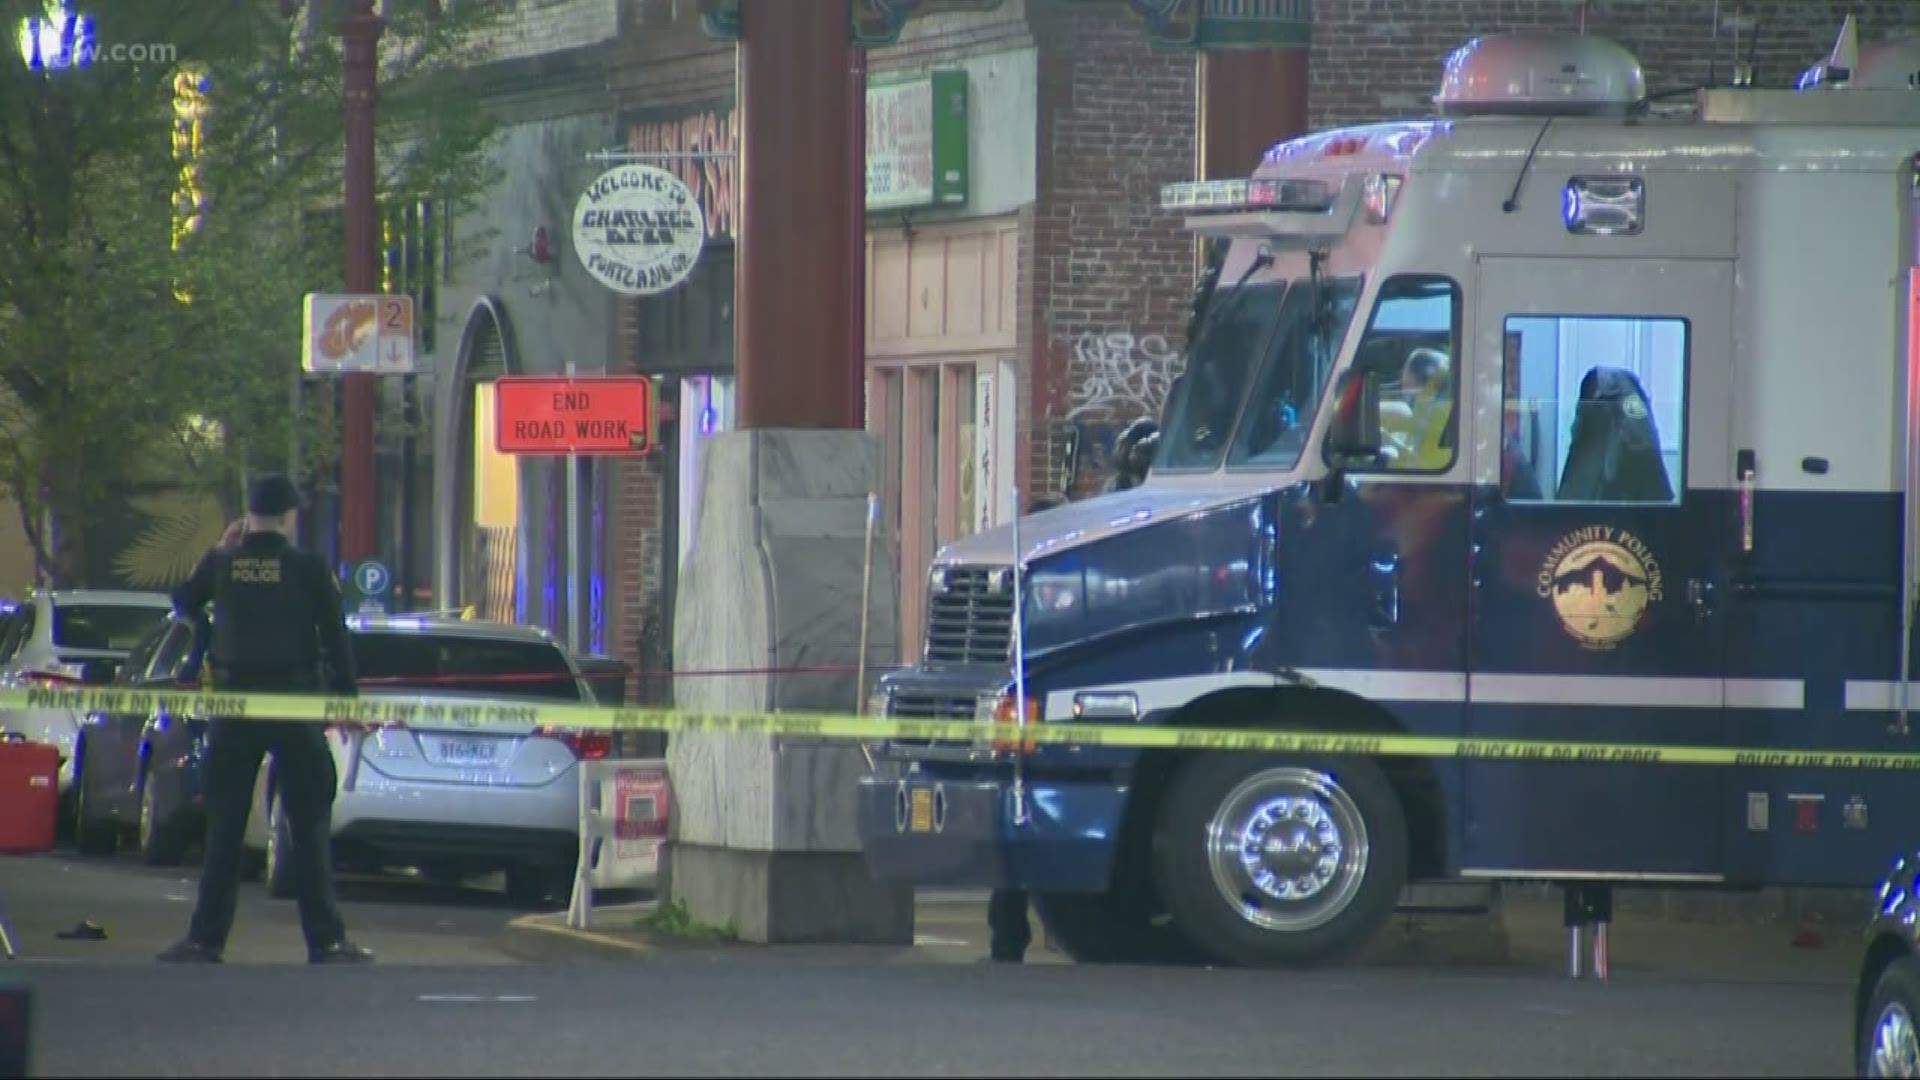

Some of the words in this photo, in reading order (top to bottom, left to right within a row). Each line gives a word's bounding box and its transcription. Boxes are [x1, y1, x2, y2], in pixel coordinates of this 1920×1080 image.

[586, 171, 664, 204] WELCOME
[387, 303, 402, 327] 2
[553, 393, 589, 411] END
[515, 421, 565, 439] ROAD
[575, 420, 628, 439] WORK
[1537, 525, 1614, 598] COMMUNITY
[1619, 530, 1663, 601] POLICING
[231, 570, 281, 583] POLICE
[365, 568, 380, 589] P
[28, 688, 83, 710] POLICE
[90, 692, 124, 712] LINE
[131, 694, 151, 713] DO
[195, 697, 247, 717] CROSS
[325, 700, 381, 720] POLICE
[386, 703, 417, 721] LINE
[1456, 742, 1509, 758] POLICE
[1514, 744, 1546, 760] LINE
[1552, 746, 1572, 762] DO
[1578, 747, 1607, 763] NOT
[1735, 752, 1789, 766] POLICE
[1794, 753, 1827, 767] LINE
[1858, 754, 1888, 768] NOT
